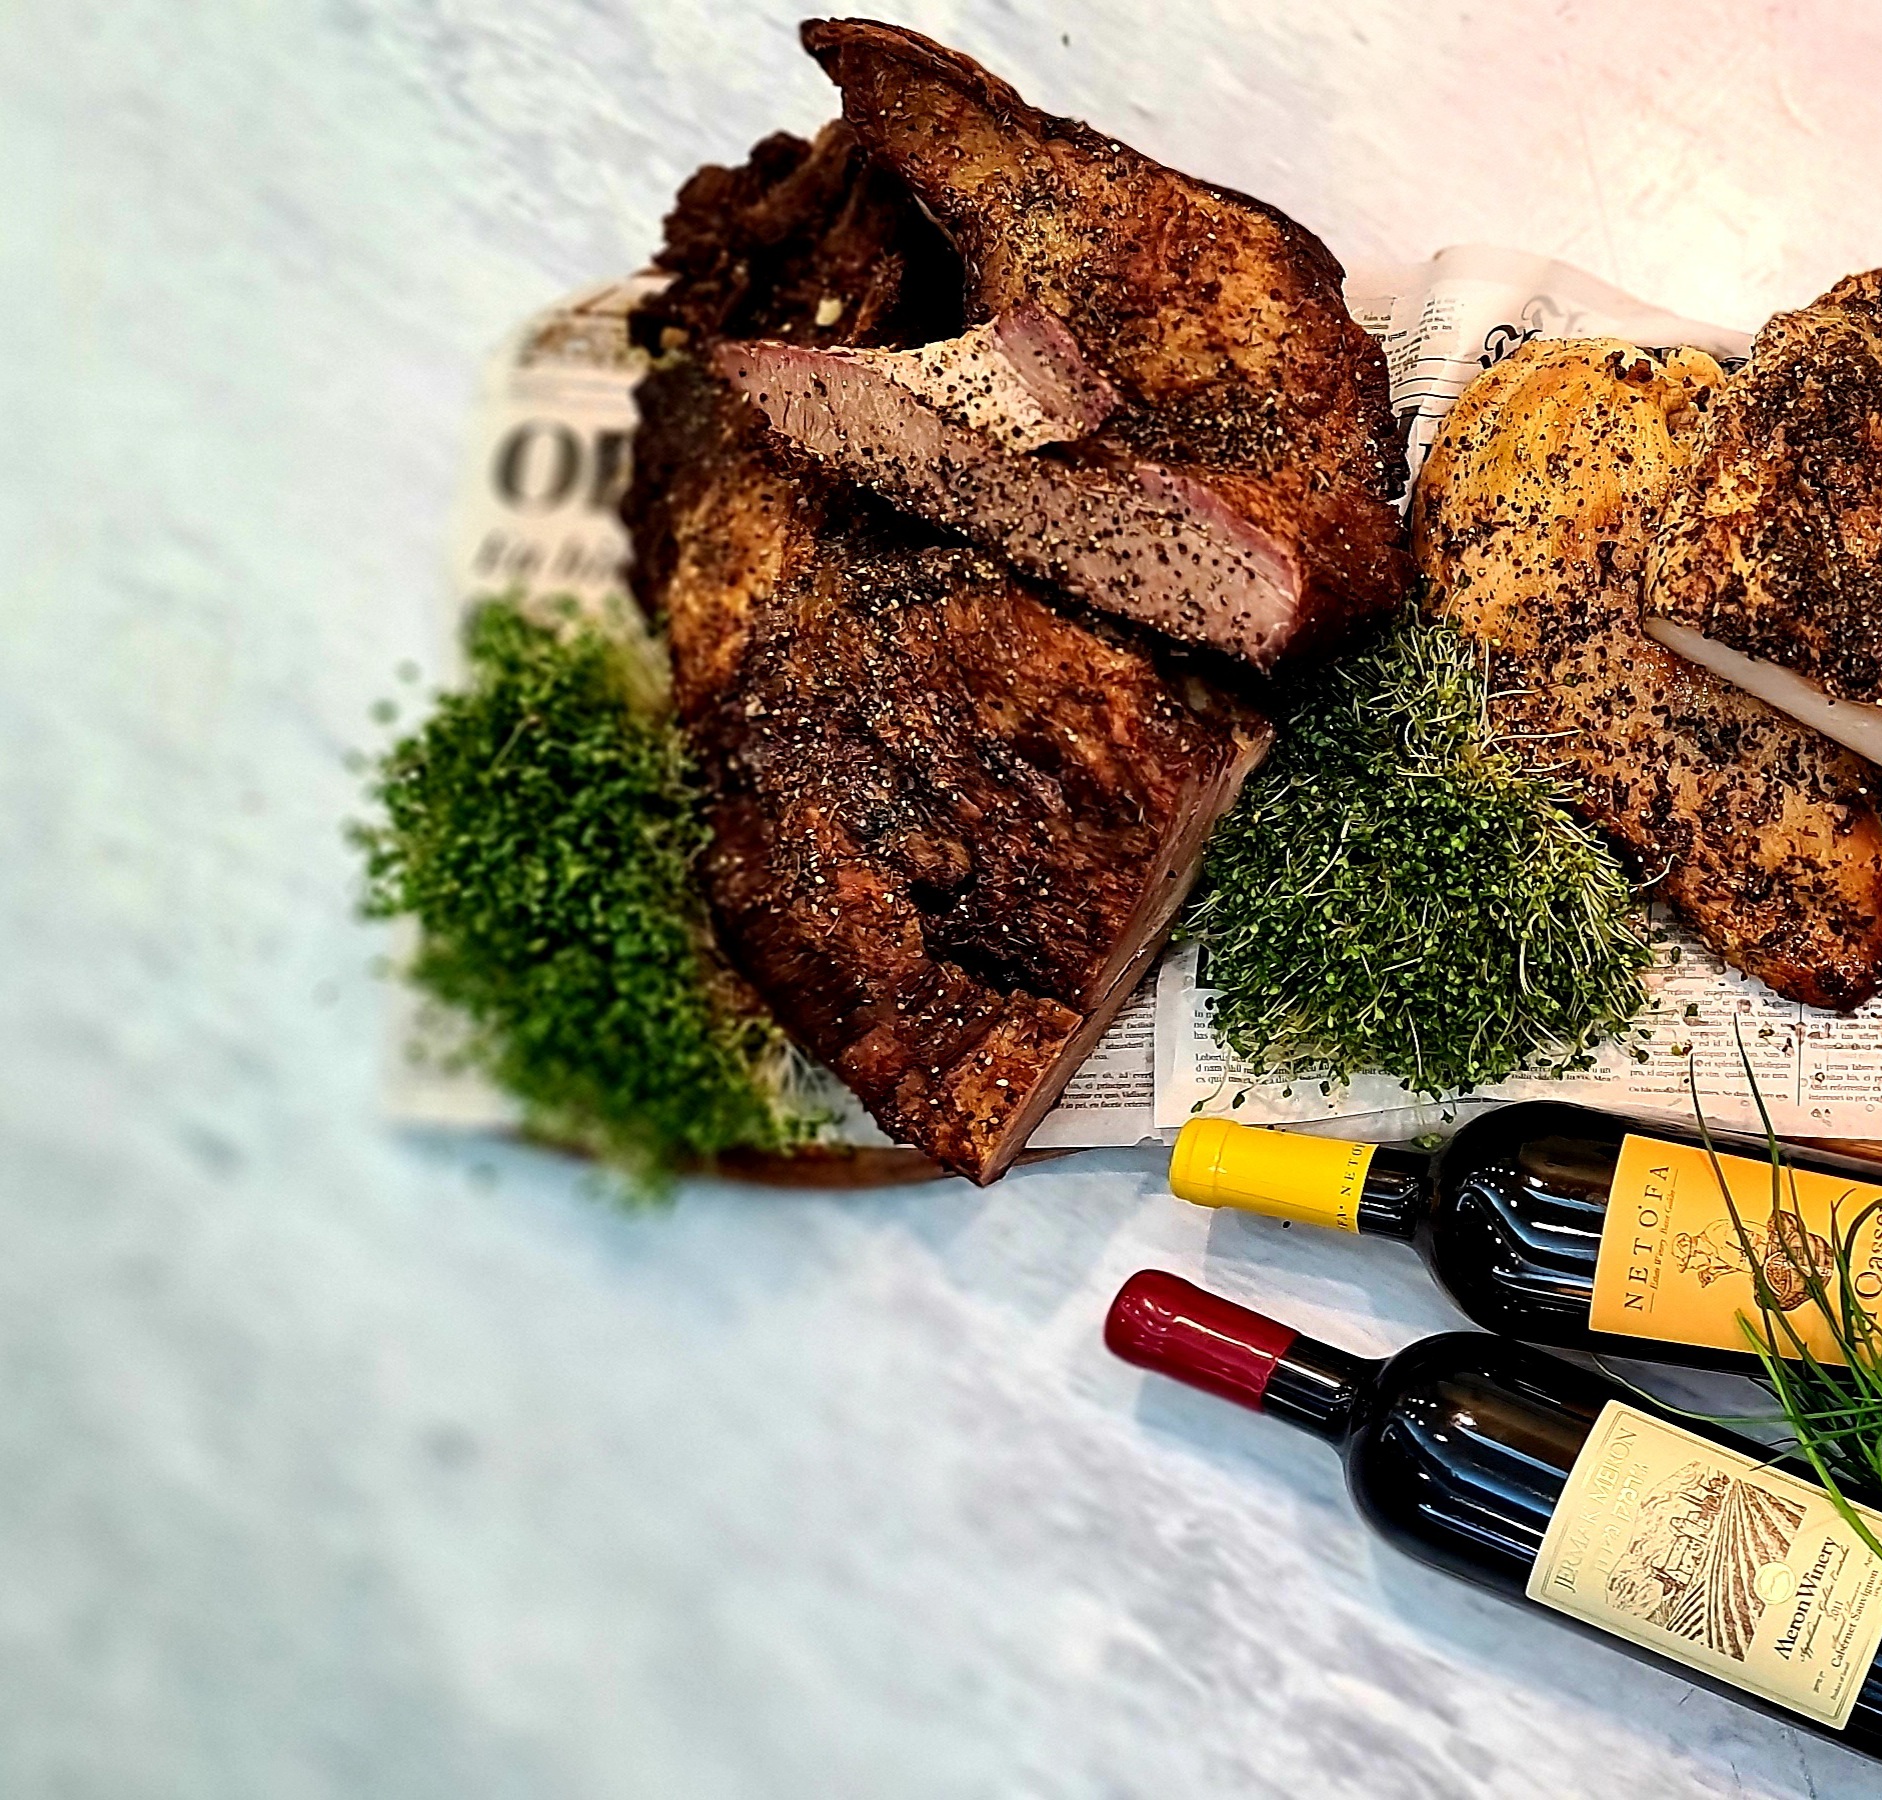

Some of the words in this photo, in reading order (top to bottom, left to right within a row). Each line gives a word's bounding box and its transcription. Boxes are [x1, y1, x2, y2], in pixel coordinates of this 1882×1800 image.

[1553, 1510, 1601, 1594] JERMAK
[1588, 1427, 1638, 1506] MERON
[1774, 1600, 1812, 1661] Meron
[1795, 1536, 1841, 1599] Winery
[1831, 1621, 1857, 1668] Cabernet
[1850, 1569, 1879, 1621] Sauvignon
[1832, 1600, 1845, 1622] 2011
